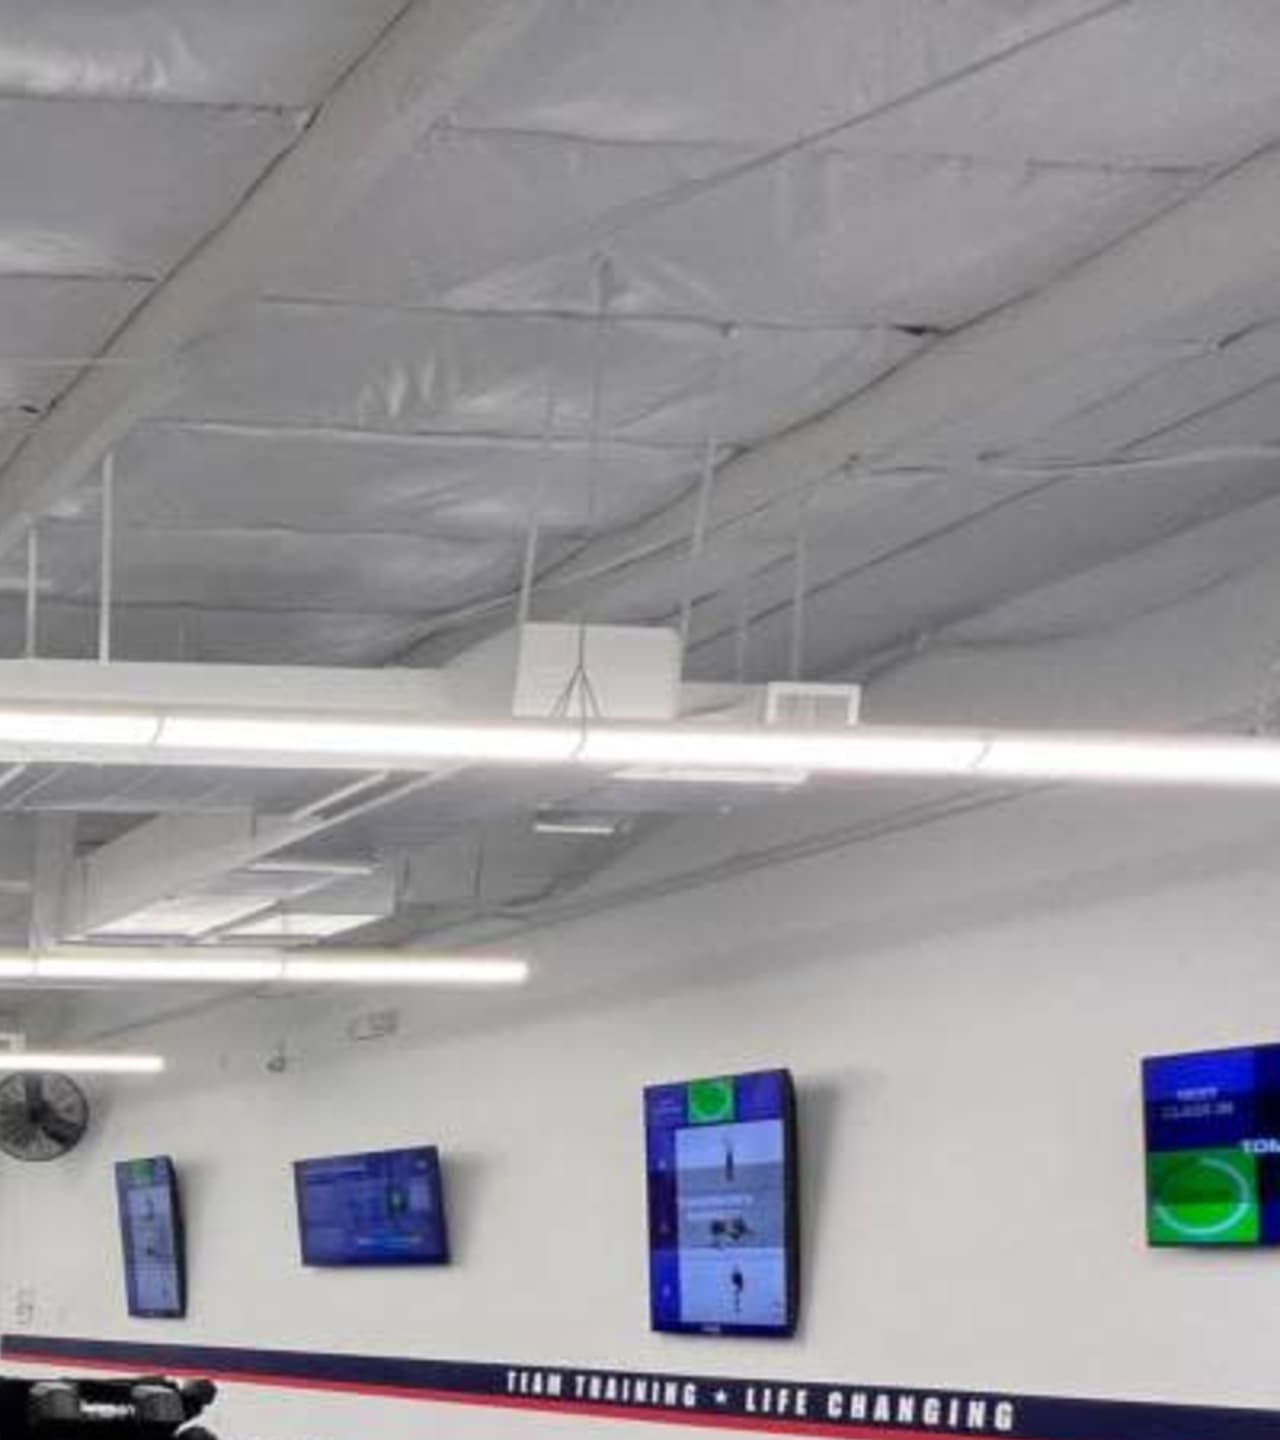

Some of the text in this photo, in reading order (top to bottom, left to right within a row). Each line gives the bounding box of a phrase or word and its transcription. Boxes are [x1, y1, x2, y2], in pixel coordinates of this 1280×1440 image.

[506, 1371, 1016, 1431] TEAM TRAINING LIFE CHANGING
